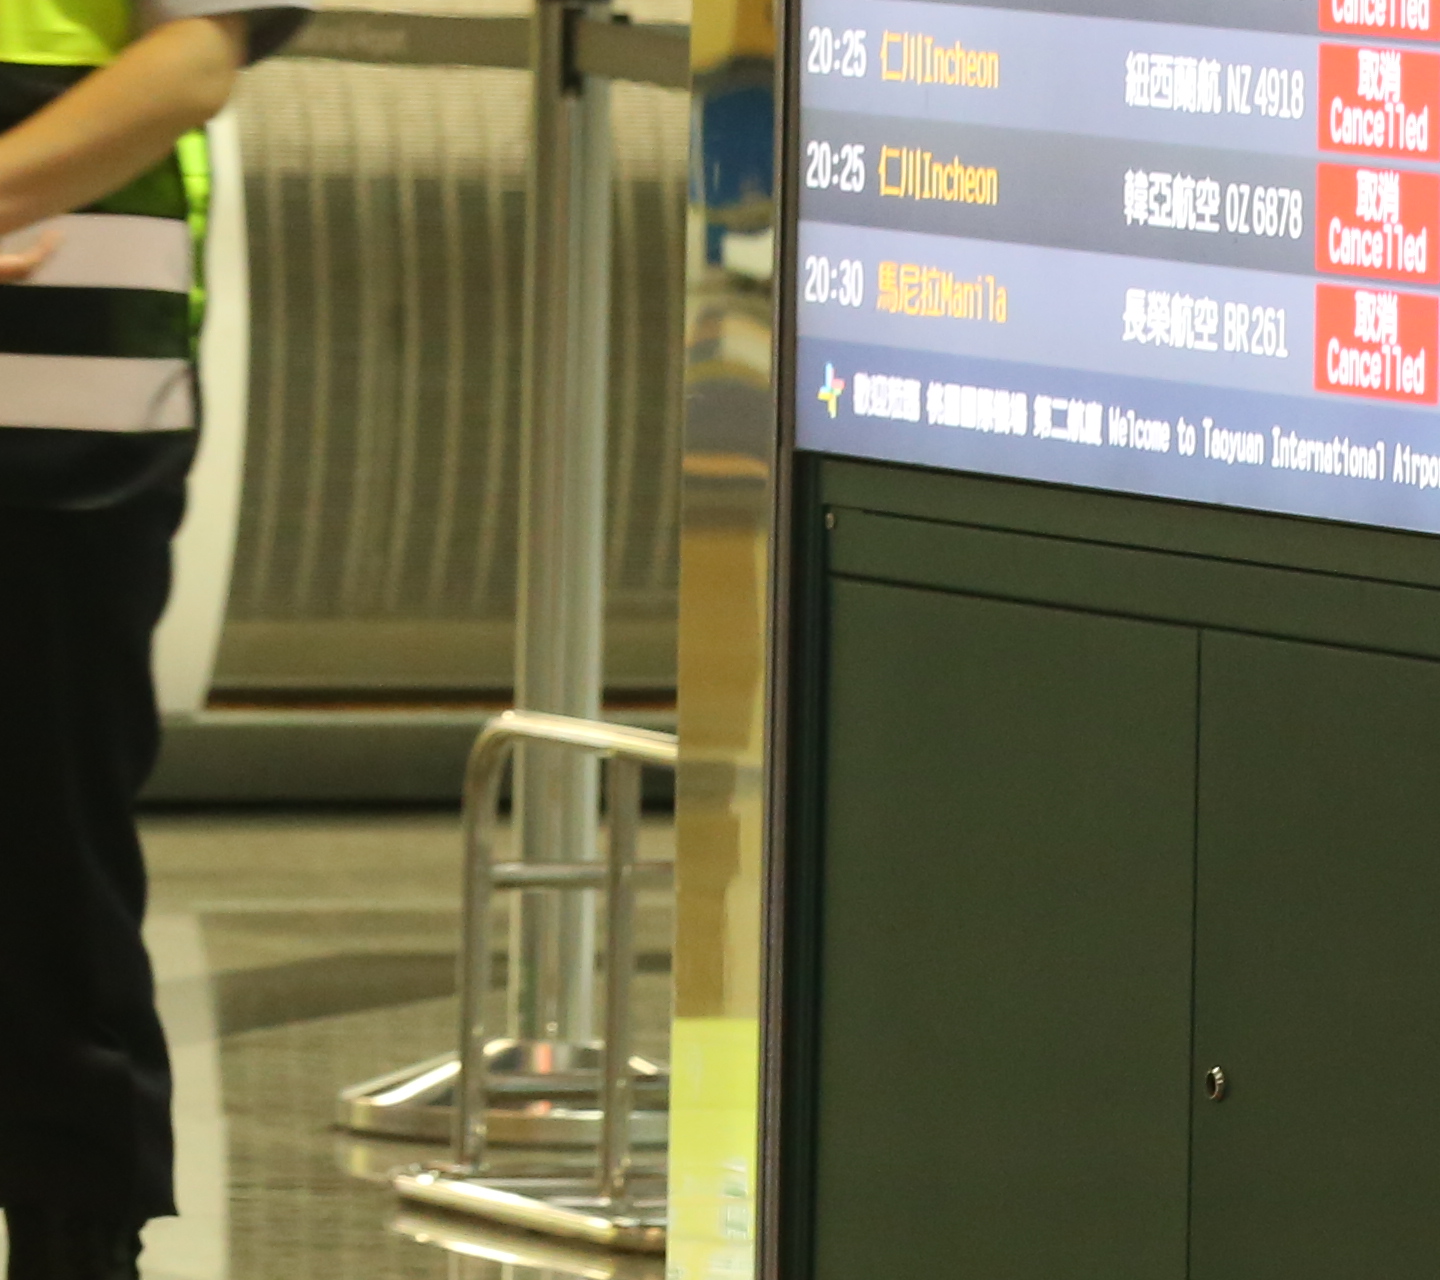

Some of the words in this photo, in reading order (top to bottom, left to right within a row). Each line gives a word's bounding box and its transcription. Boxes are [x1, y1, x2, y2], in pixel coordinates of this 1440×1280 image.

[806, 140, 865, 192] 20:25
[1124, 169, 1220, 232] 韓亞航空
[1356, 169, 1400, 223] 取消
[1328, 217, 1427, 273] Cancelled
[1108, 406, 1171, 452] Welcome
[1177, 417, 1196, 456] to
[1202, 417, 1264, 465] Taoyuan
[1271, 425, 1384, 480] International
